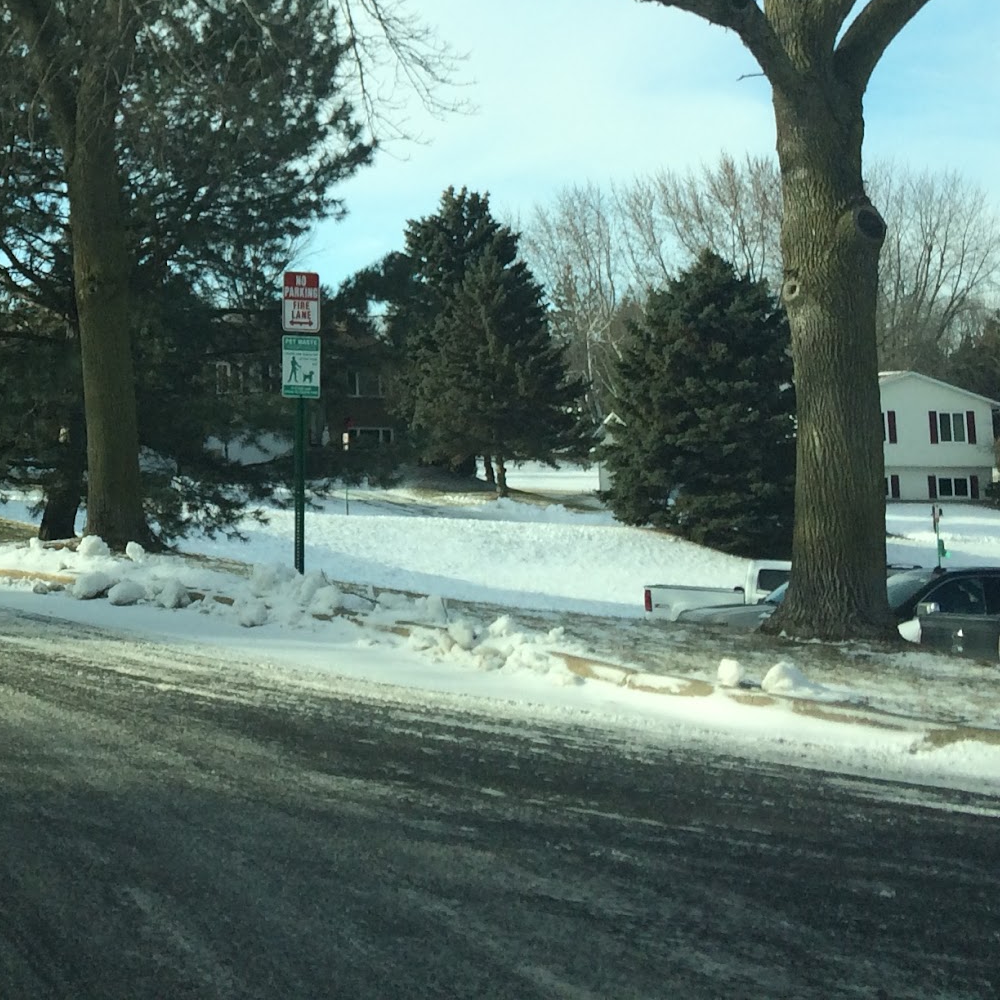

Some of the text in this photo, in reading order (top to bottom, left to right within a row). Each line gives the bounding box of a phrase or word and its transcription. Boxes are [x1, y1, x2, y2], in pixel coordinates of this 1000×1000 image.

[296, 275, 307, 286] NO
[284, 286, 318, 299] PARKING
[293, 301, 310, 310] FIRE
[291, 310, 311, 320] LANE
